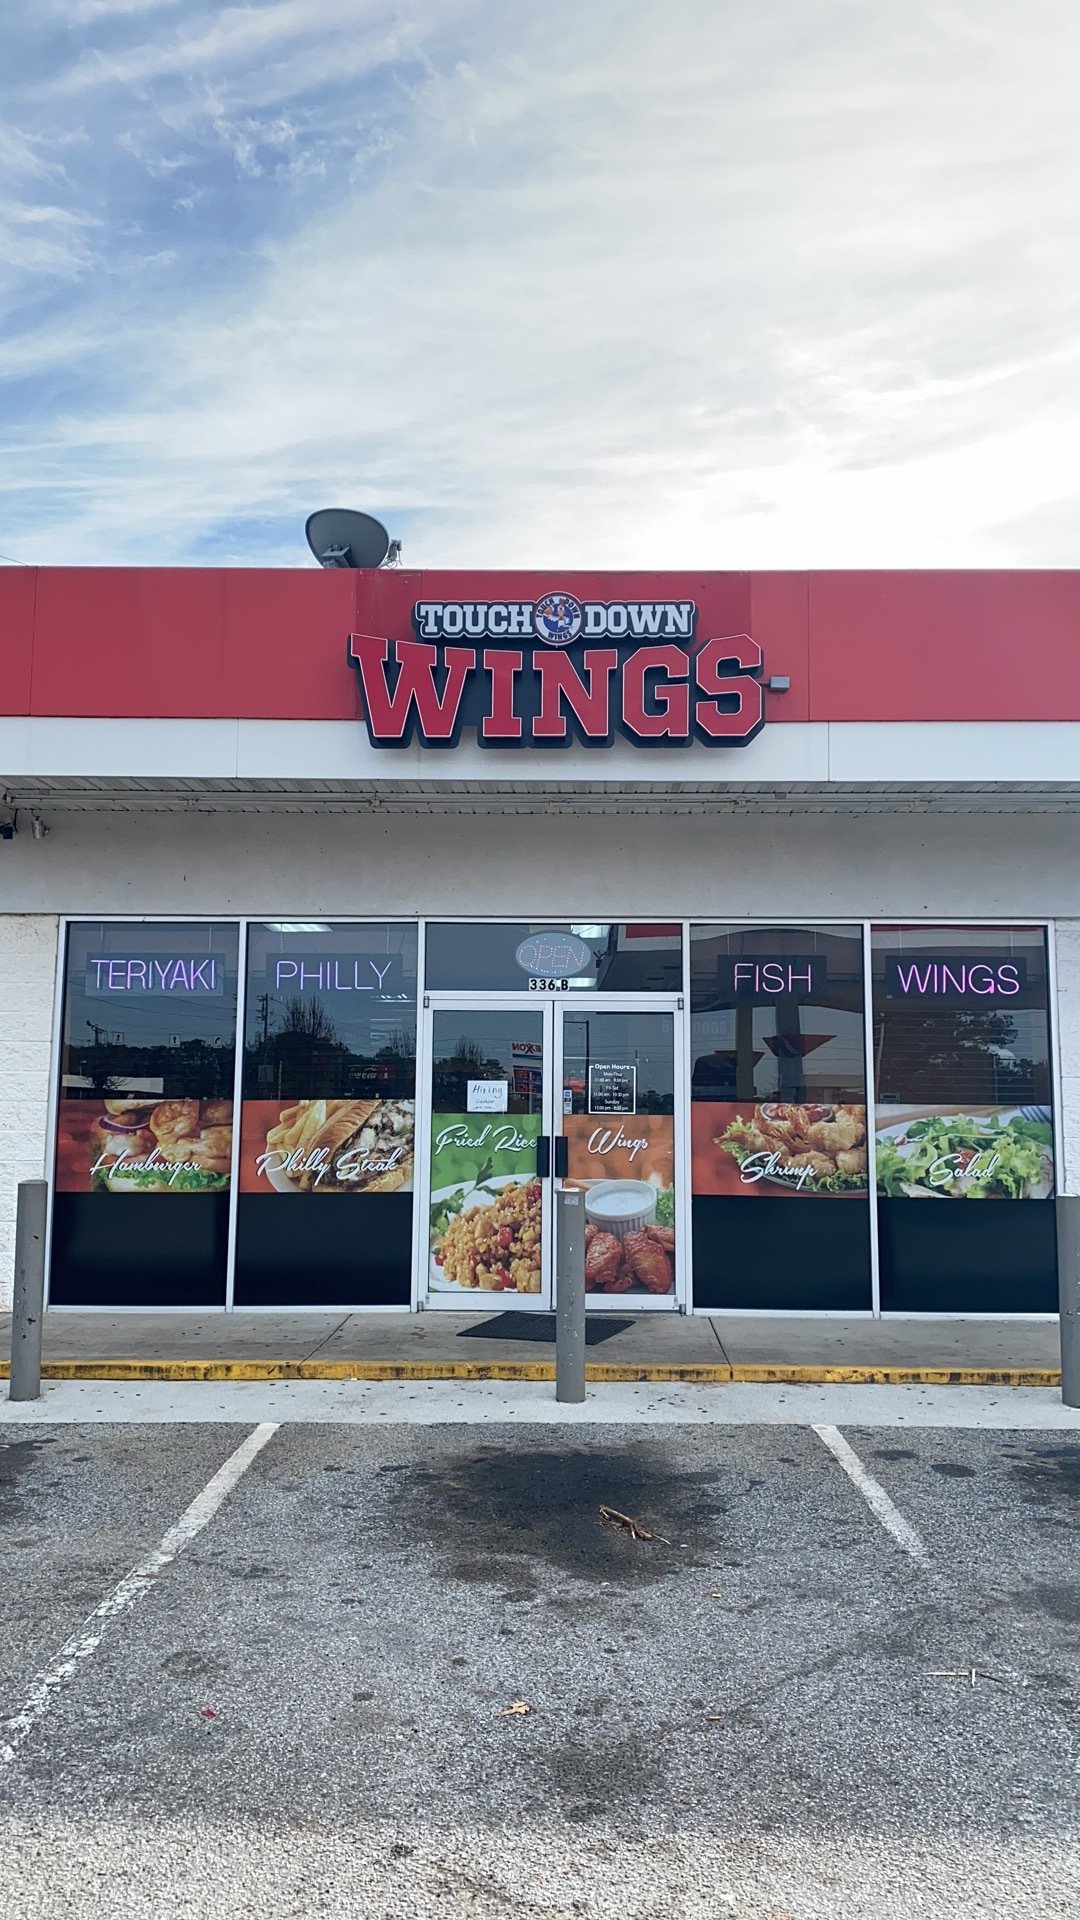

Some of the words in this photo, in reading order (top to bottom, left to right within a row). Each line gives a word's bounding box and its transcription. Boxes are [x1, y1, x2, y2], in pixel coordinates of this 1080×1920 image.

[419, 604, 533, 633] TOUCH
[585, 604, 691, 633] DOWN
[548, 630, 573, 641] WINGS
[350, 633, 763, 738] WINGS
[519, 945, 585, 968] OPEN
[90, 958, 216, 990] TERIYAKI
[275, 960, 393, 990] PHILLY
[530, 979, 555, 990] 336
[561, 979, 568, 990] B
[734, 963, 812, 994] FISH
[897, 964, 1020, 996] WINGS
[472, 1084, 503, 1099] Hiring
[435, 1123, 493, 1155] Fried
[492, 1125, 538, 1153] Rice
[587, 1125, 649, 1162] Wings
[89, 1148, 202, 1186] Hamburger
[255, 1149, 331, 1185] Philly
[335, 1148, 404, 1180] Steak
[740, 1151, 818, 1189] Shrimp
[929, 1153, 1001, 1186] Salad
